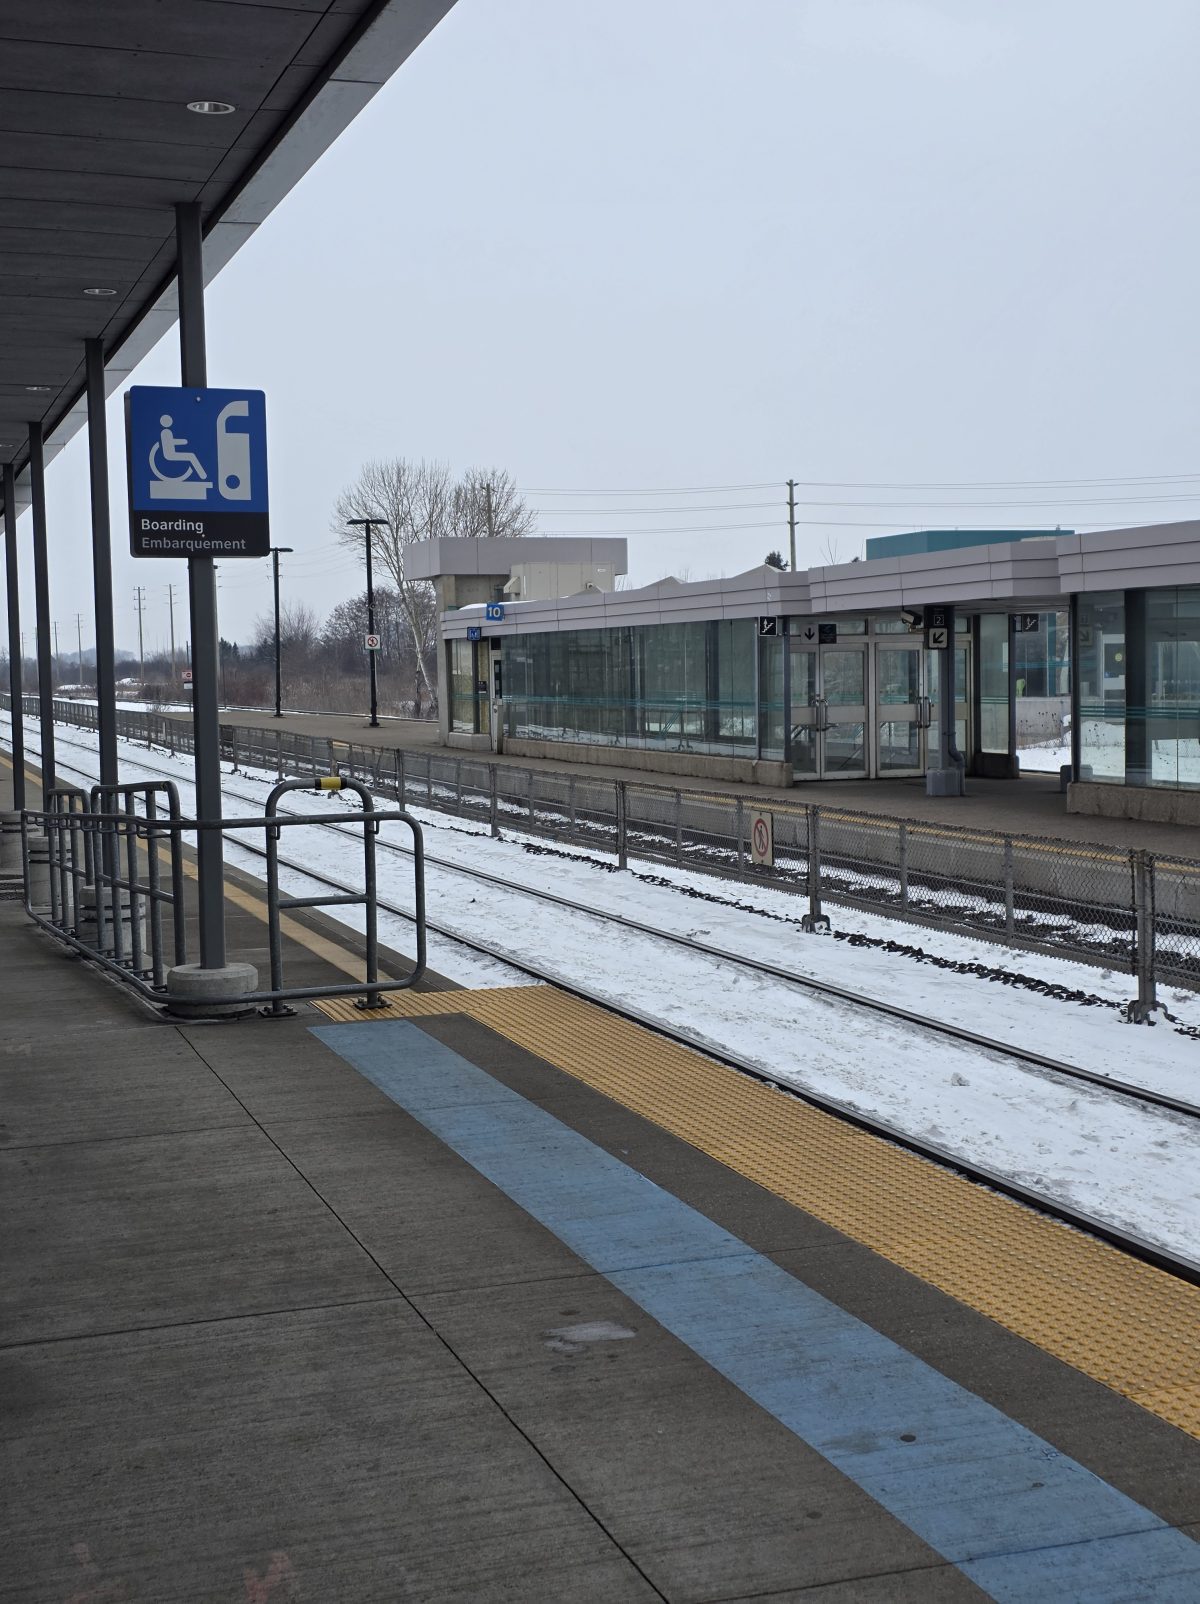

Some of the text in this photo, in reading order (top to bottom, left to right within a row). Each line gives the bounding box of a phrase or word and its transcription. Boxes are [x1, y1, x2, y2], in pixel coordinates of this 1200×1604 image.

[141, 519, 204, 534] Boarding
[142, 537, 246, 551] Embarquement
[488, 607, 501, 618] 10
